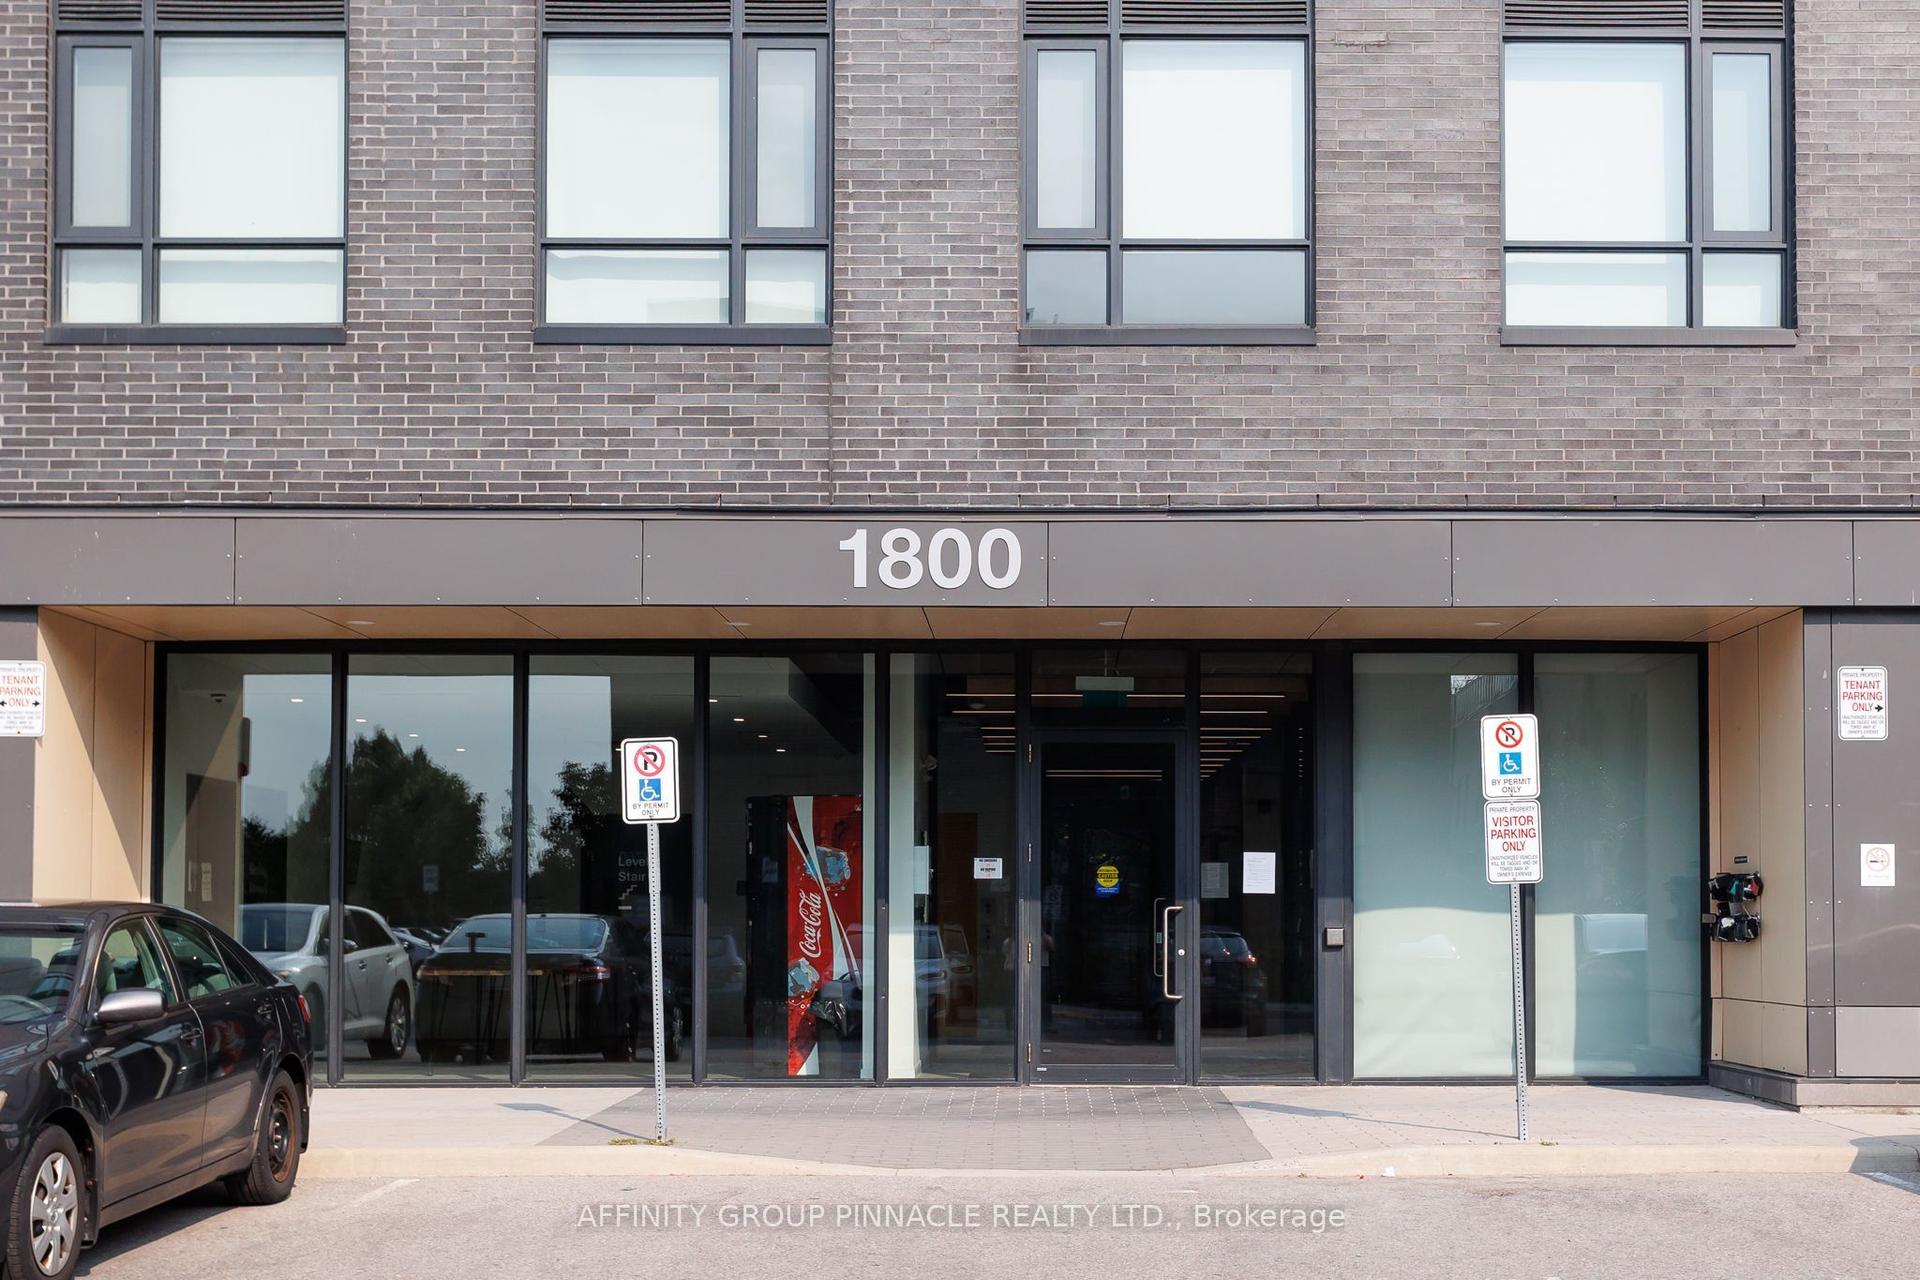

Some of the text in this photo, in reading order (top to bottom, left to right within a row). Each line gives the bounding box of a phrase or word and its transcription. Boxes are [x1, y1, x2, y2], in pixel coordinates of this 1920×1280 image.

[839, 527, 1022, 590] 1800
[2, 675, 38, 685] TENANT
[1844, 680, 1881, 690] TENANT
[0, 687, 41, 696] PARKING
[1842, 691, 1883, 701] PARKING
[8, 698, 30, 707] ONLY
[1852, 702, 1874, 712] ONLY
[1491, 815, 1534, 827] VISITOR
[1490, 828, 1537, 839] PARKING
[1502, 841, 1526, 852] ONLY
[618, 855, 649, 867] Leve
[618, 871, 646, 881] Stair
[799, 889, 822, 958] Coca-Cola
